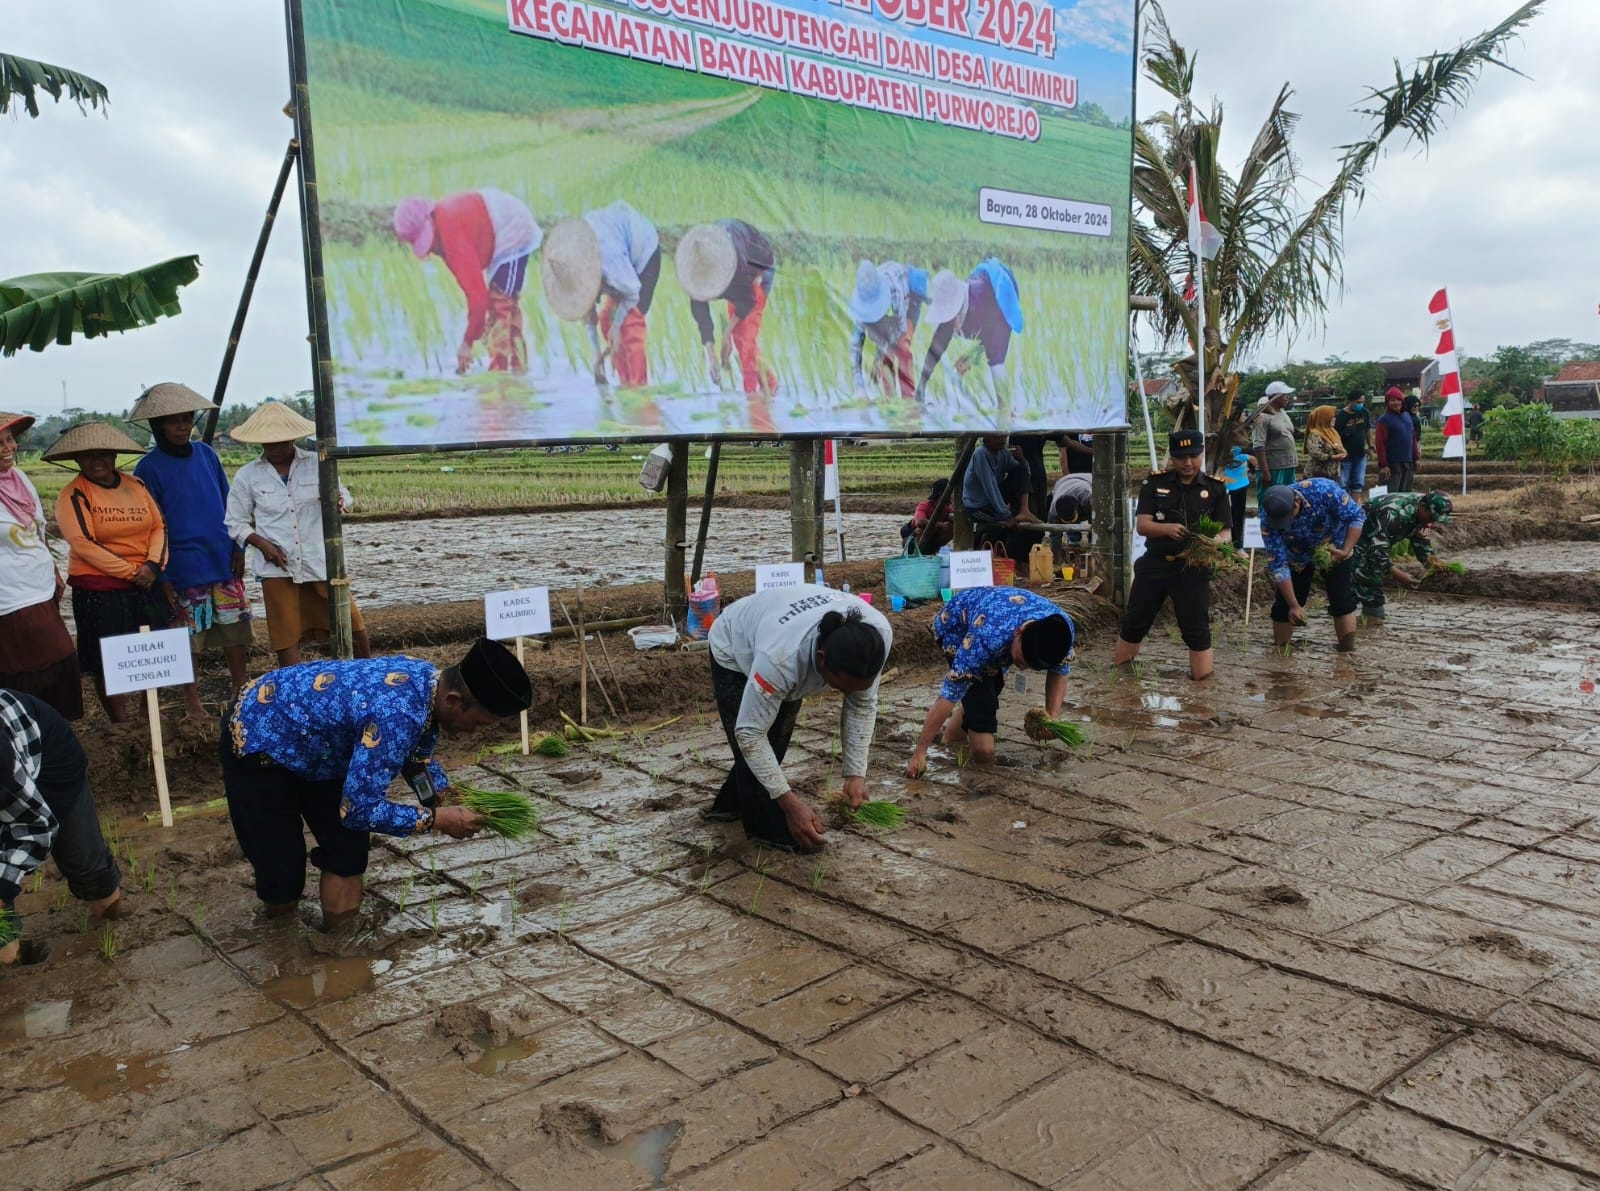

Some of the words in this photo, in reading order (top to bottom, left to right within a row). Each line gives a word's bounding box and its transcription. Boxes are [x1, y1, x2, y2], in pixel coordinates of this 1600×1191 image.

[978, 0, 1055, 52] 2024
[510, 0, 692, 65] KECAMATAN
[700, 38, 784, 85] BAYAN
[792, 61, 919, 114] KABUPATEN
[925, 90, 1040, 138] PURWOREJO
[885, 36, 931, 72] DAN
[937, 49, 987, 86] DESA
[992, 61, 1077, 105] KALIMIRU
[986, 198, 1022, 219] Bayan,
[1025, 204, 1038, 219] 28
[1041, 206, 1083, 224] Oktober
[1084, 212, 1108, 227] 2024
[503, 597, 531, 607] KADES
[127, 641, 164, 654] LURAH
[117, 654, 177, 670] SUCENJURU
[127, 669, 171, 683] TENGAH
